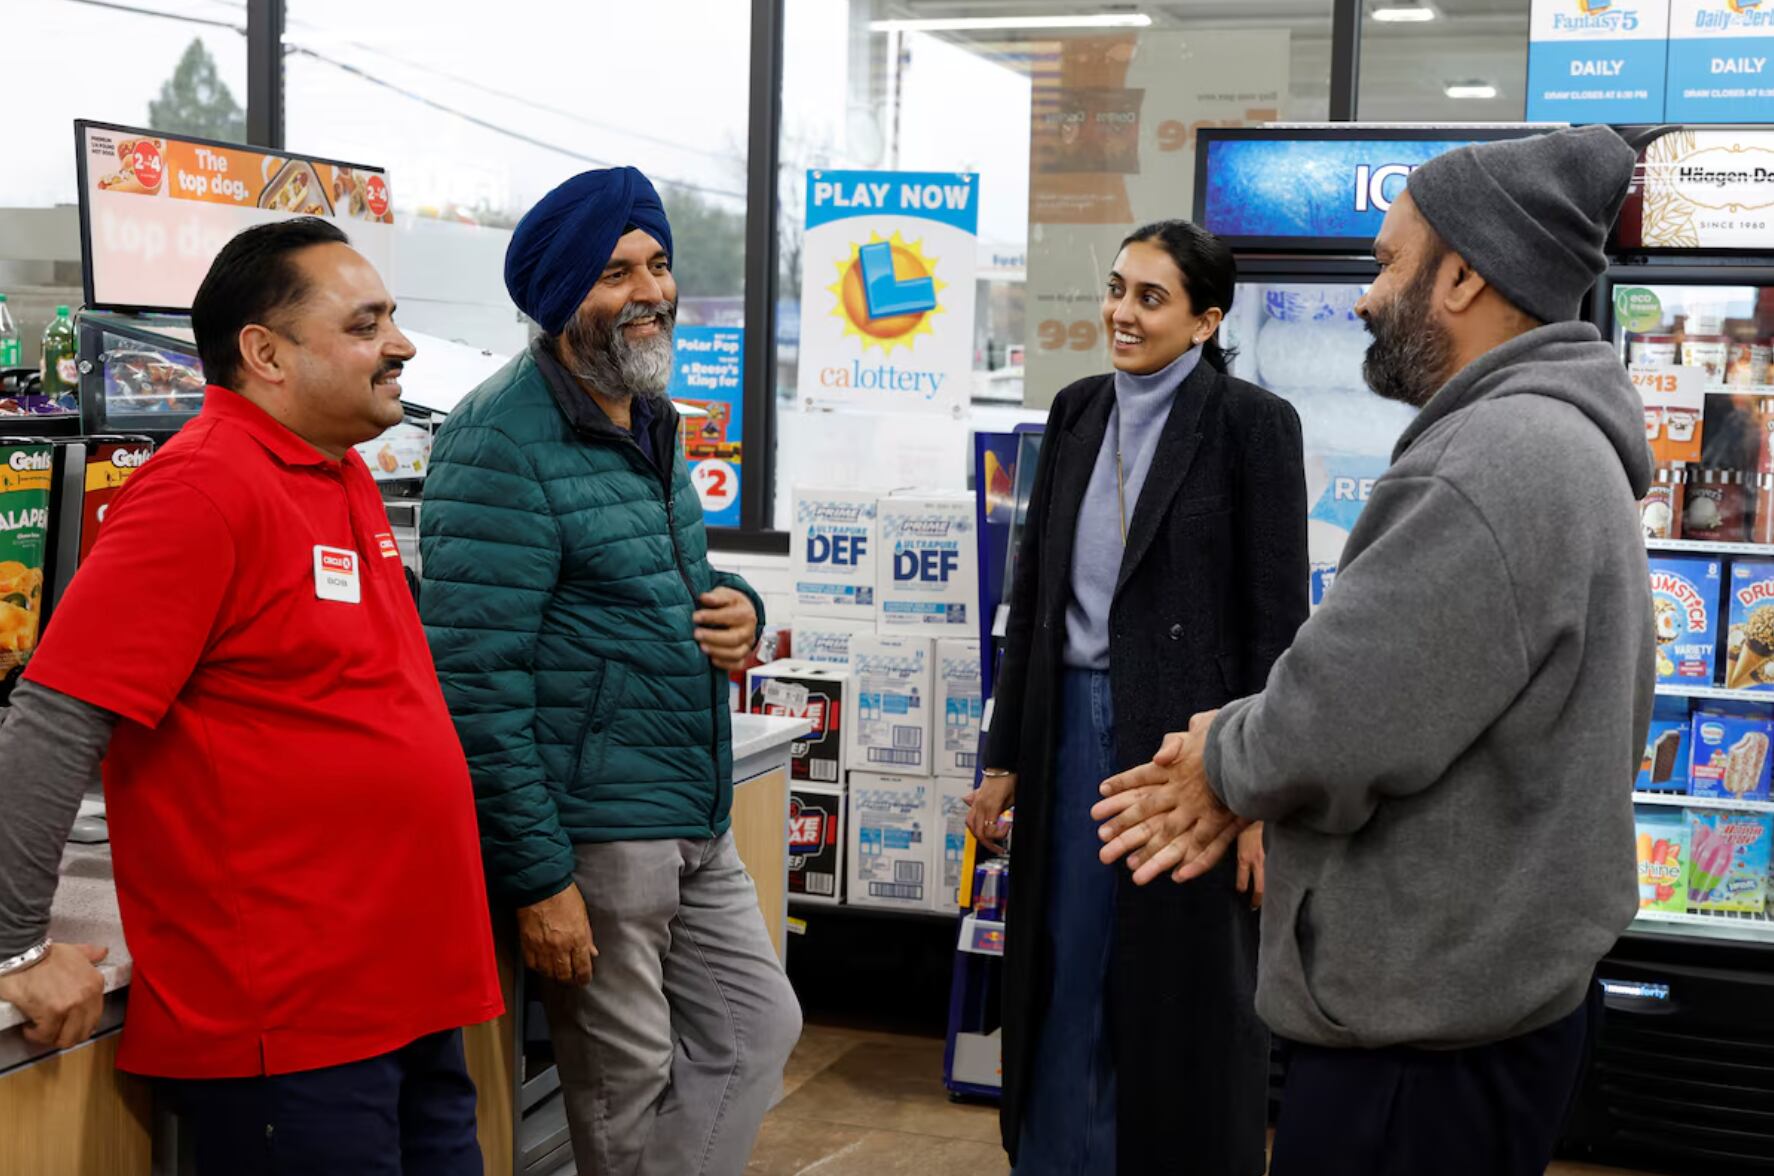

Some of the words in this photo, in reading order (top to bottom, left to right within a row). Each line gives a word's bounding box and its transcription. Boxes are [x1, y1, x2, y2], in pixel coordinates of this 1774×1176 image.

[1553, 12, 1620, 29] Fantasy
[1622, 11, 1639, 30] 5
[1695, 9, 1731, 30] Daily
[1570, 60, 1625, 76] DAILY
[1711, 57, 1766, 74] DAILY
[194, 148, 228, 172] The
[178, 169, 207, 197] top
[211, 173, 249, 201] dog.
[814, 182, 890, 207] PLAY
[901, 185, 970, 210] NOW
[1354, 163, 1419, 213] IC
[1700, 222, 1735, 230] SINCE
[1740, 222, 1767, 230] 1960
[101, 212, 166, 263] top
[677, 338, 711, 351] Polar
[713, 340, 739, 354] Pop
[688, 374, 717, 389] King
[719, 375, 739, 387] for
[820, 360, 945, 399] calottery
[807, 533, 867, 566] DEF
[894, 548, 959, 582] DEF
[1638, 861, 1680, 878] shine
